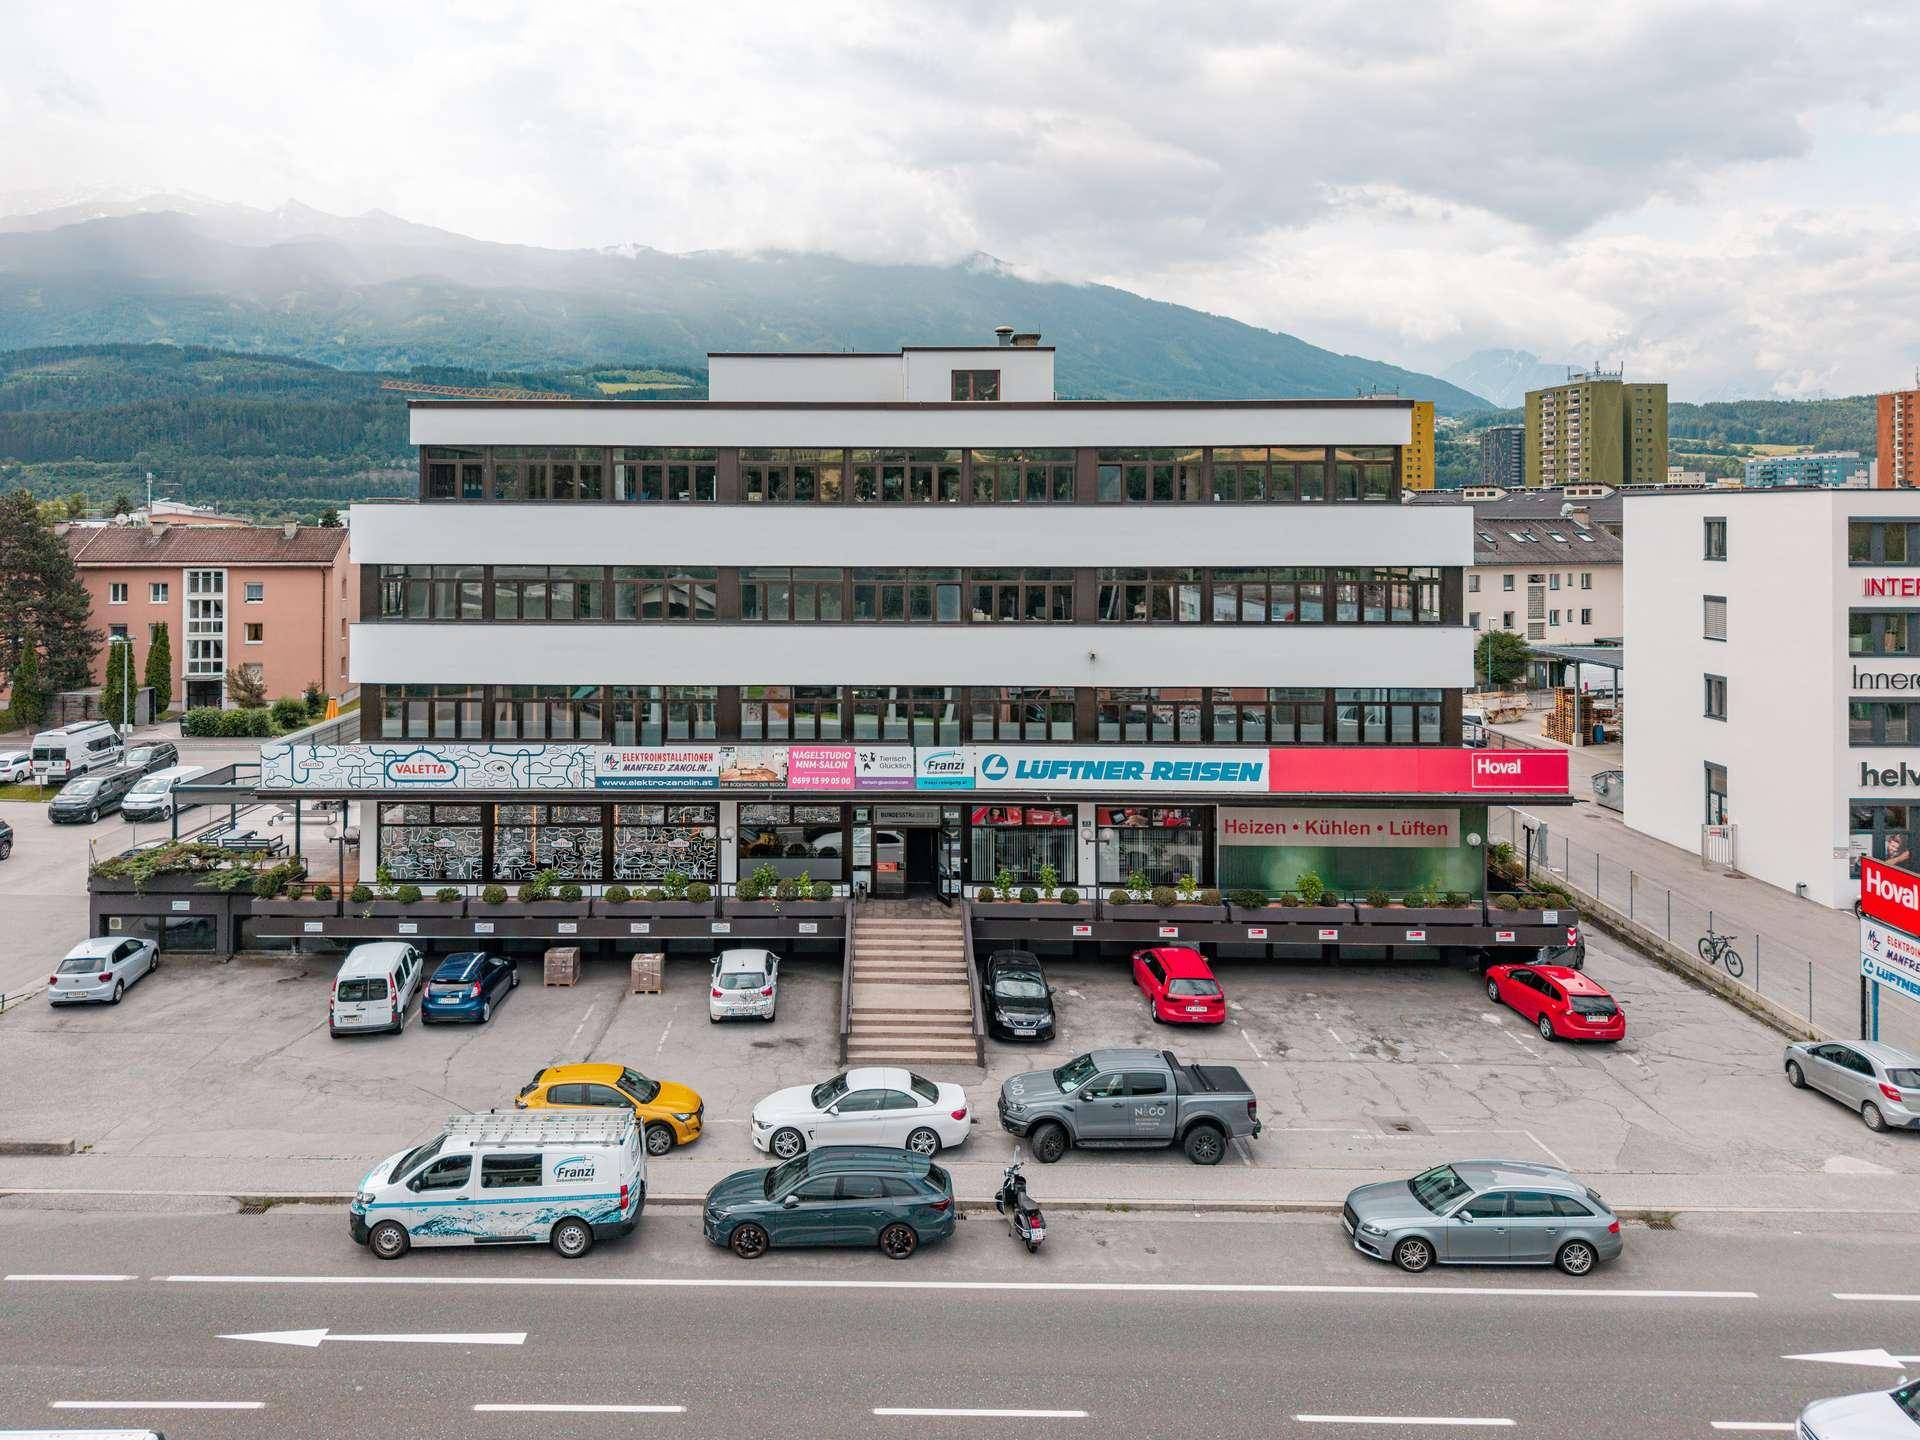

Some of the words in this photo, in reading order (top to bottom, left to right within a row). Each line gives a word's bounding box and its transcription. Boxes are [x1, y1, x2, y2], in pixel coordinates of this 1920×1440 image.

[1853, 664, 1920, 689] Inner
[622, 752, 714, 762] ELEKTROINSTALLATIONEN
[792, 751, 851, 760] NAGELSTUDIO
[395, 764, 447, 774] VALETTA
[622, 763, 666, 772] MANFRED
[667, 763, 708, 772] ZANOLIN
[927, 759, 965, 771] Franzi
[1477, 758, 1522, 775] Hoval
[602, 778, 713, 786] www.elektro-zanolin.at
[1224, 819, 1287, 834] Heizen
[1305, 818, 1370, 836] Kühlen
[1390, 820, 1448, 837] Lüften
[1866, 867, 1919, 911] Hoval
[557, 1163, 595, 1178] Franzi
